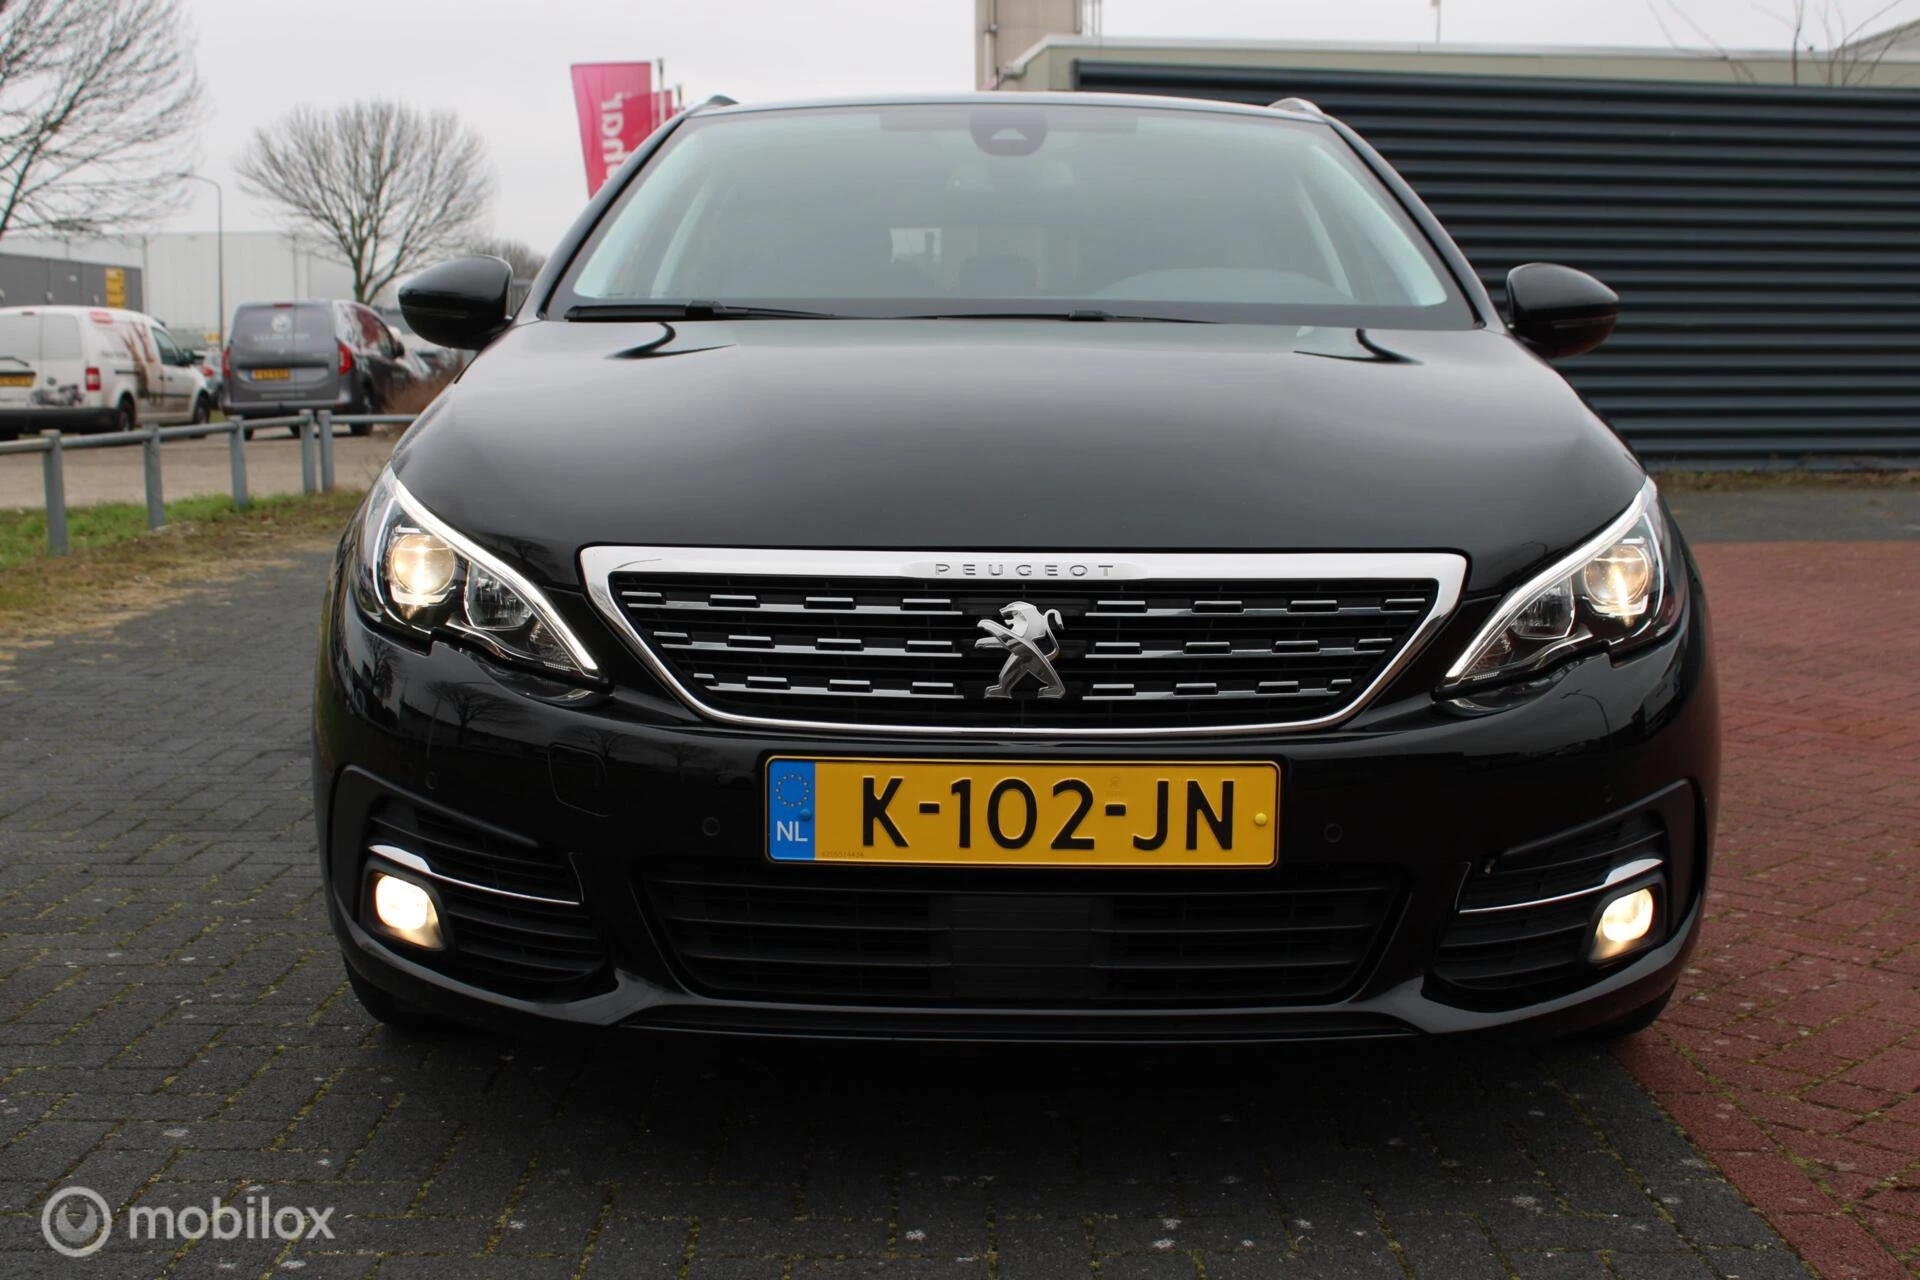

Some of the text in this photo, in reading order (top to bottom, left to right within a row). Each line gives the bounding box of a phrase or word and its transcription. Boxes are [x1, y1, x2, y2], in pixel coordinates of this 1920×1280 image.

[935, 563, 1114, 577] PEUGEOT
[862, 776, 1235, 851] K-102-JN
[776, 820, 809, 842] NL
